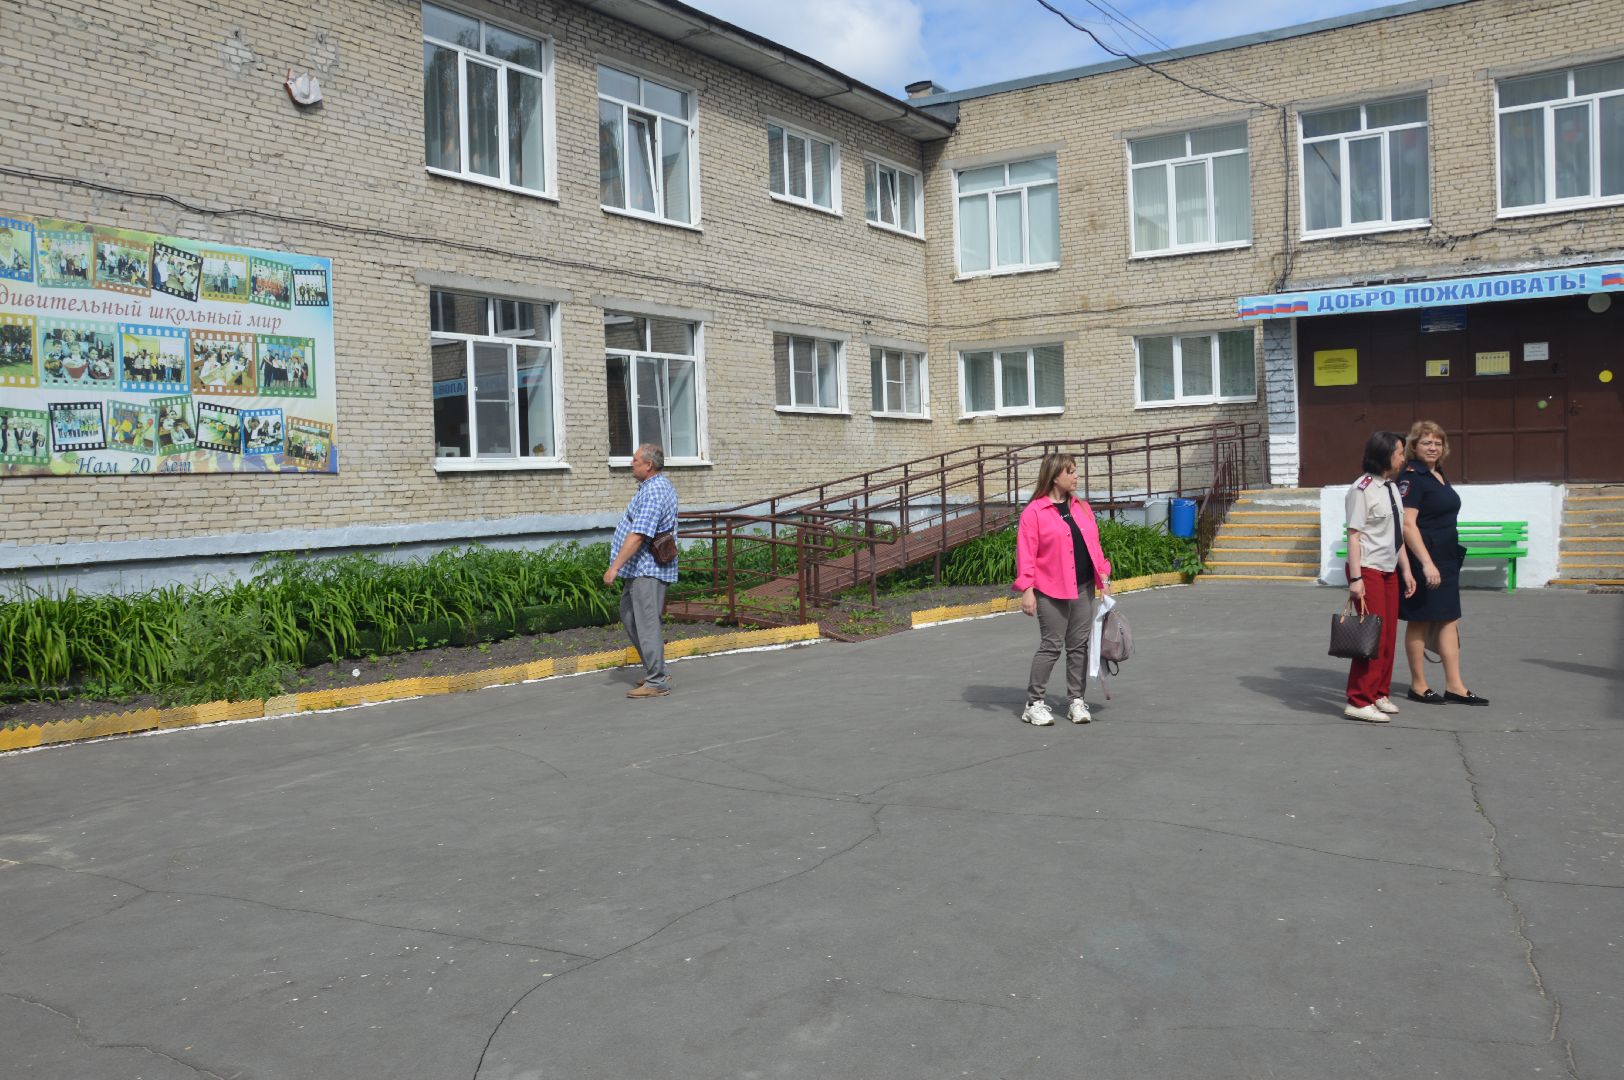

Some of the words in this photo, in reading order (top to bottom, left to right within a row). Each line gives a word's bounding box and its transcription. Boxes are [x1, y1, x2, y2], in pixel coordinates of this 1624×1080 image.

[1317, 290, 1396, 312] ДОБРО
[1404, 273, 1586, 304] ПОЖАЛОВАТЬ!
[149, 306, 242, 326] школьный
[247, 315, 282, 334] мир
[75, 456, 119, 474] Нам
[130, 457, 151, 473] 20
[160, 461, 192, 473] лет
